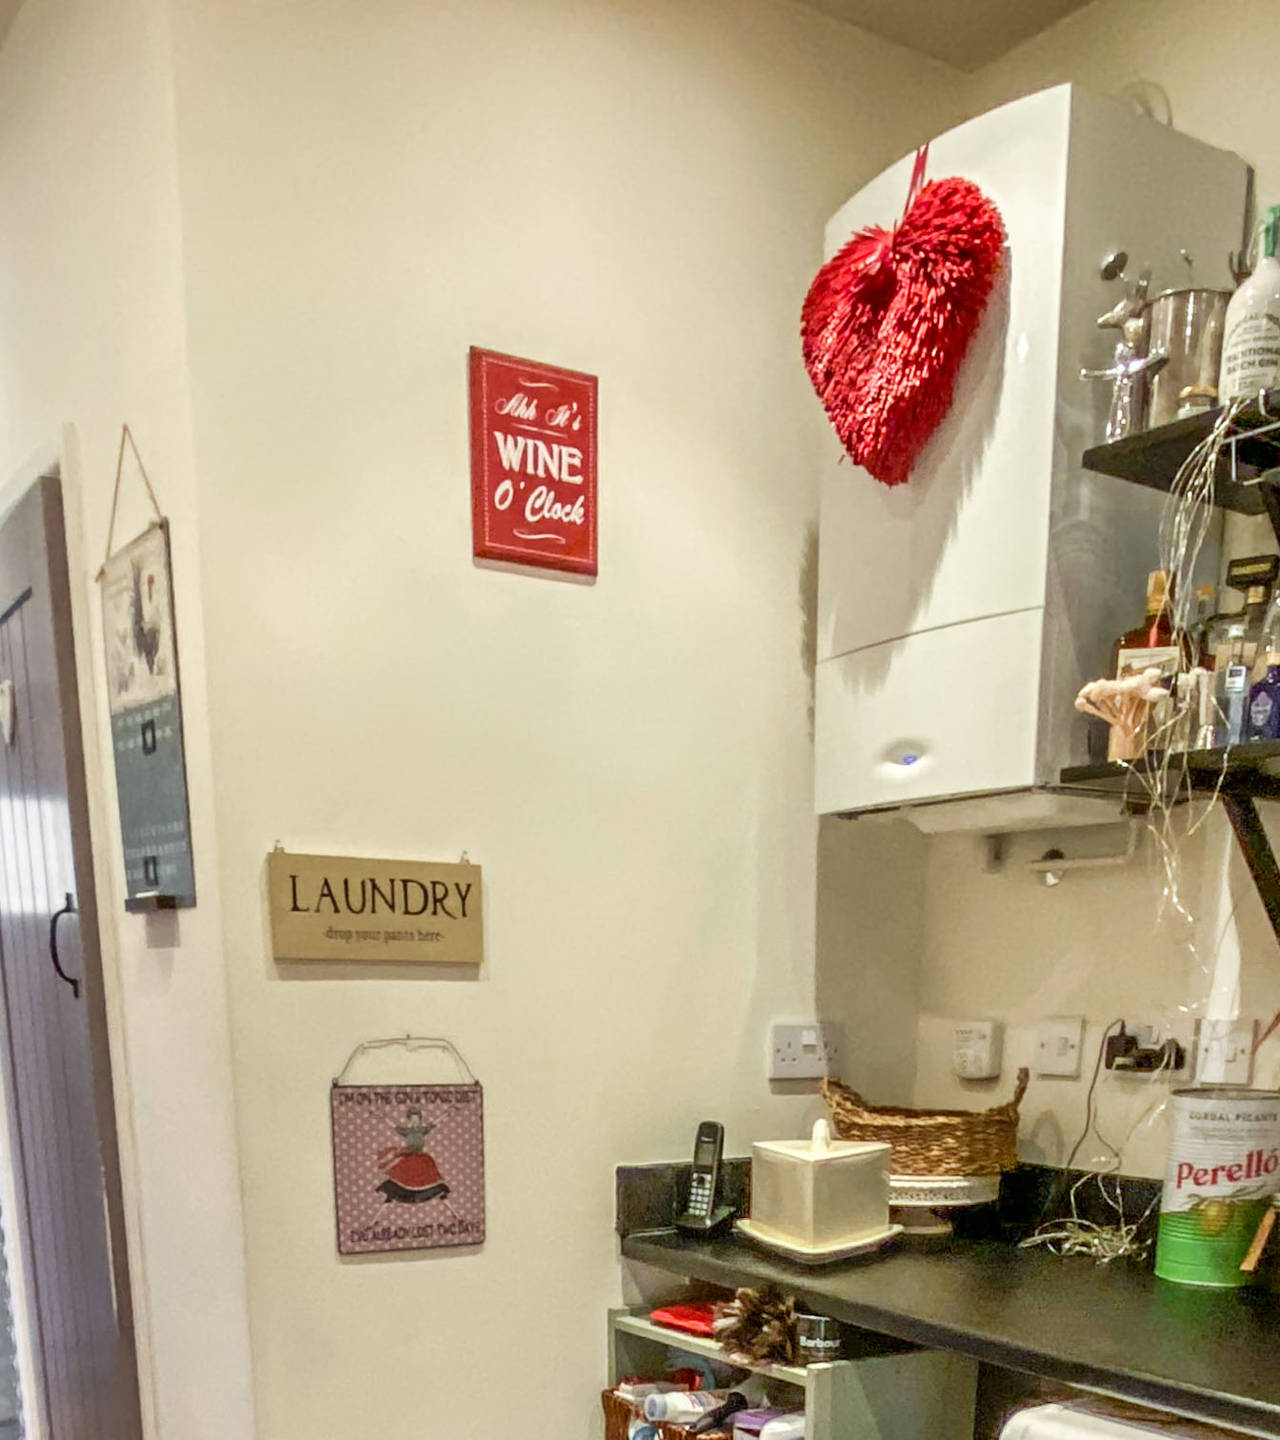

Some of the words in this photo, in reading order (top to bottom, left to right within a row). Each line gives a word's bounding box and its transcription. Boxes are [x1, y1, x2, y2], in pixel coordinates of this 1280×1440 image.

[494, 393, 538, 422] Ahh
[493, 431, 584, 486] WINE
[524, 485, 586, 526] Clock
[289, 875, 473, 921] LAUNDRY
[1176, 1148, 1280, 1190] Perelló
